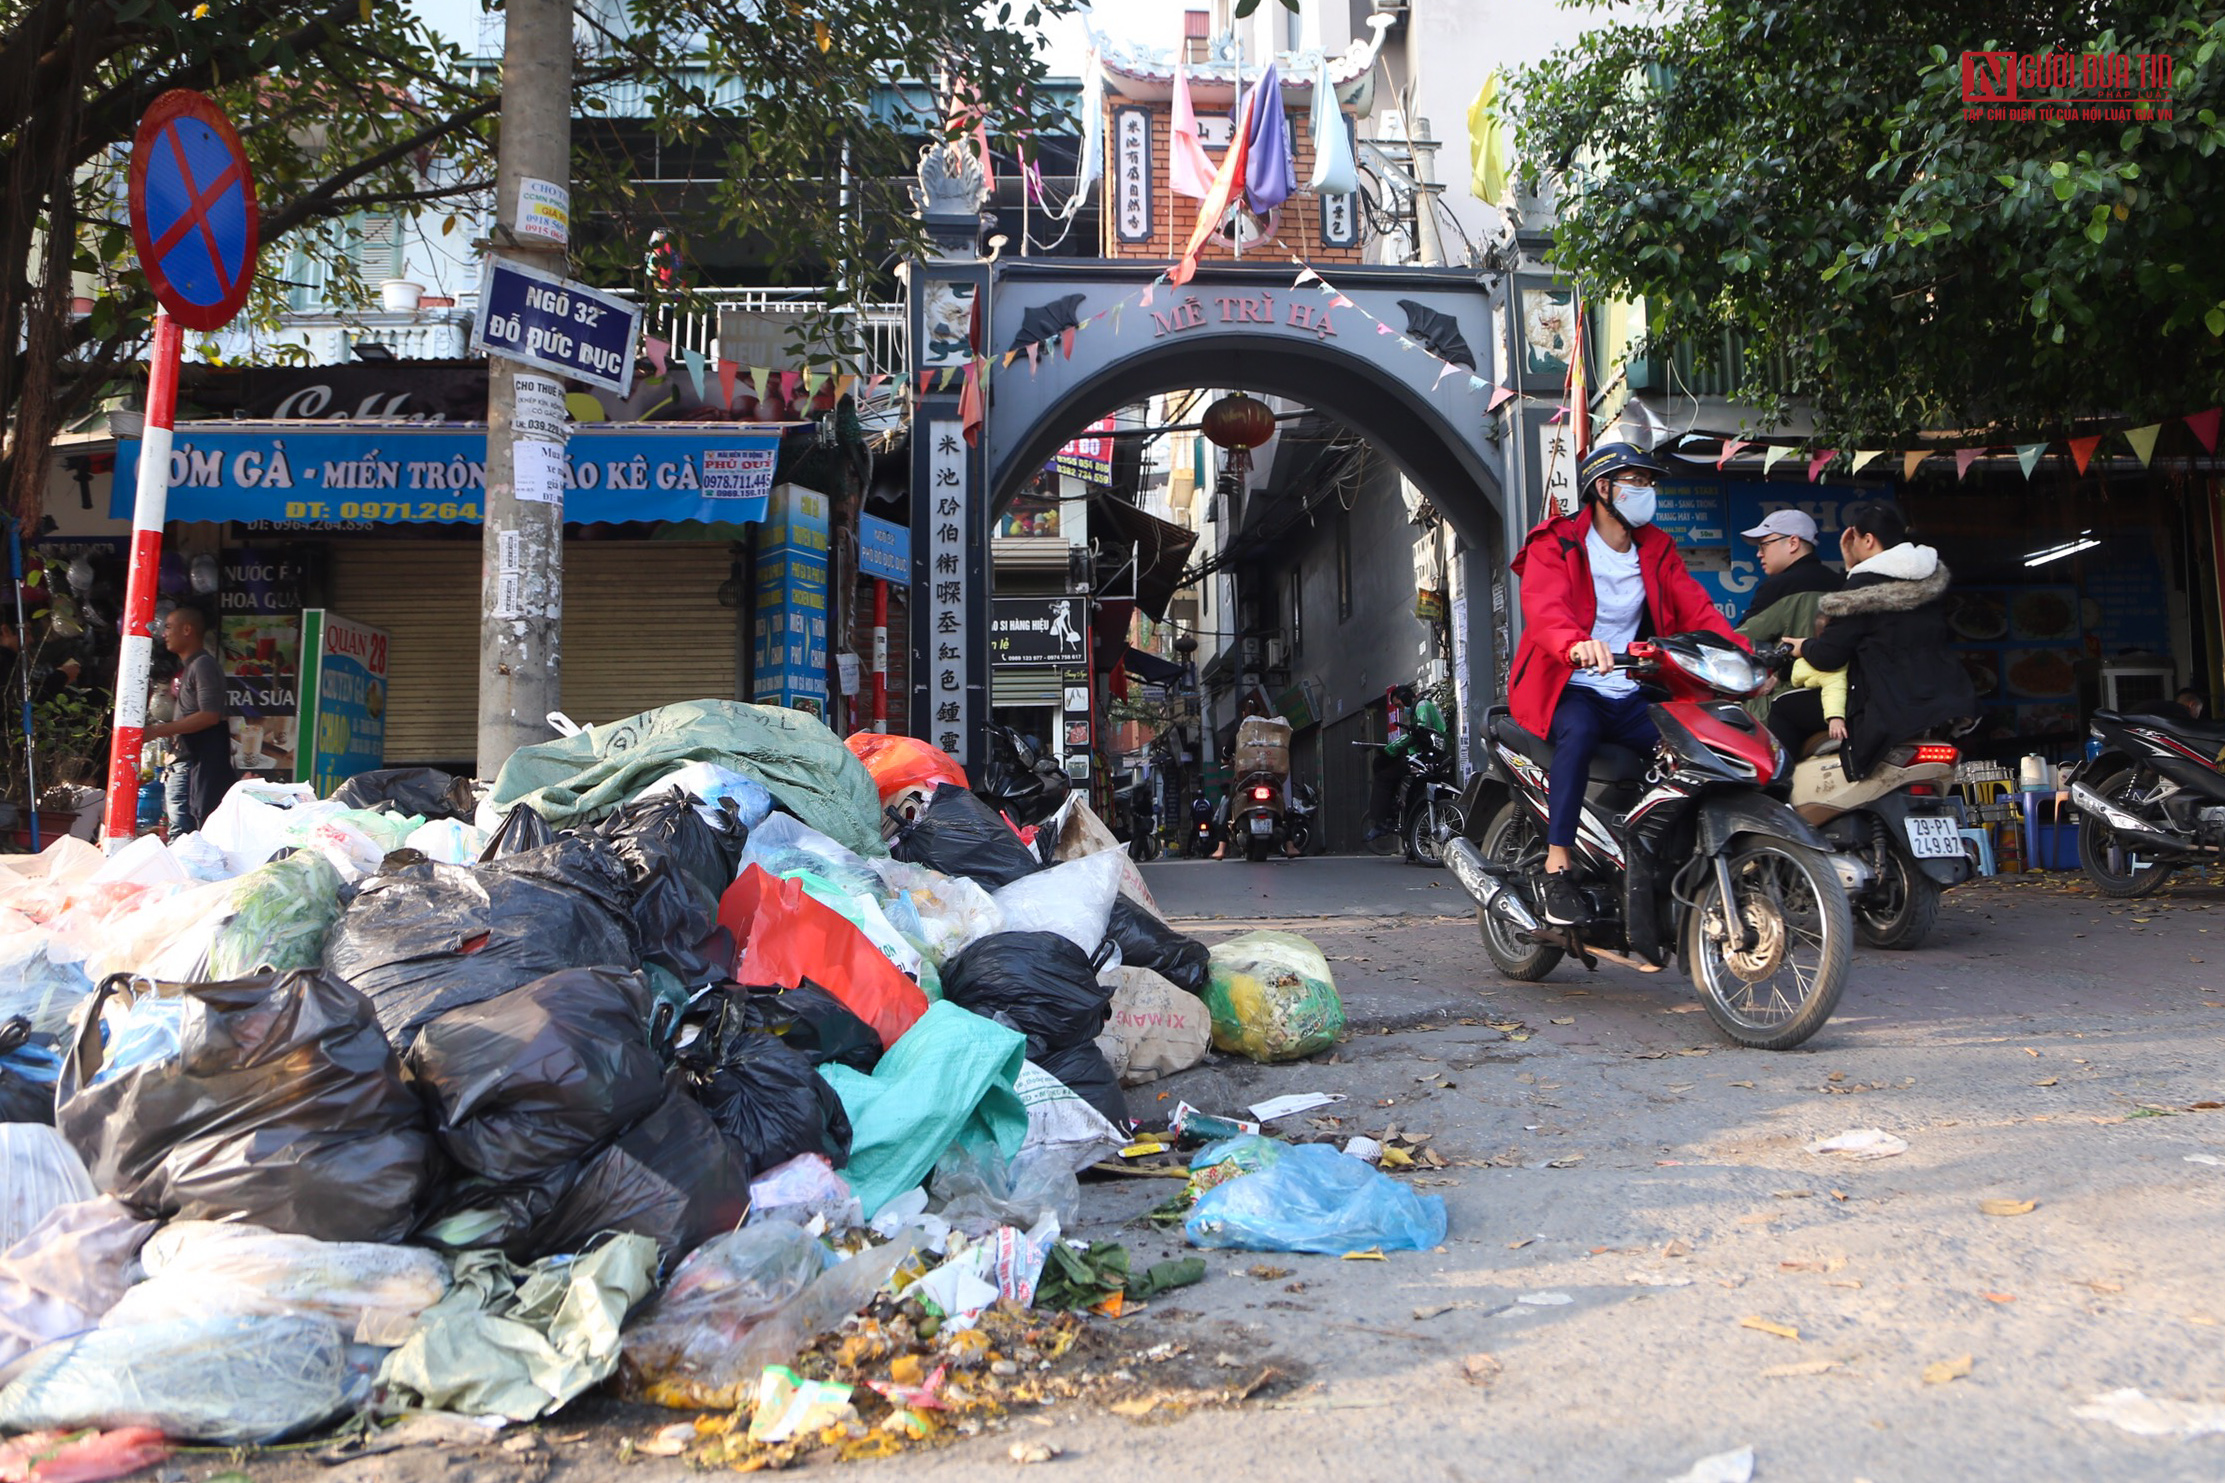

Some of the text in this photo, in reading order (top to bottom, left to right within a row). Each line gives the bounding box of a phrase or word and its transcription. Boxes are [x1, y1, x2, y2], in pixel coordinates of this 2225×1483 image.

[531, 182, 557, 195] CHO
[525, 285, 600, 328] NGÕ 32
[1150, 291, 1338, 340] MỄ TRÌ HẠ
[489, 312, 521, 343] ĐỖ
[527, 326, 573, 359] ĐỨC
[516, 381, 534, 391] CHO
[135, 443, 226, 489] ƠM
[233, 440, 295, 489] GÀ
[322, 448, 403, 489] MIẾN
[407, 454, 488, 496] TRỘN
[606, 454, 650, 490] KÊ
[656, 455, 702, 490] GÀ
[286, 502, 332, 518] ĐT:
[223, 562, 274, 582] NƯỚC
[221, 592, 258, 608] HOA
[1009, 618, 1030, 631] HÀNG
[1032, 617, 1049, 633] HIỆU
[327, 625, 388, 675] QUÁN 28
[1913, 819, 1951, 836] 29-P1
[1914, 837, 1959, 855] 249.87
